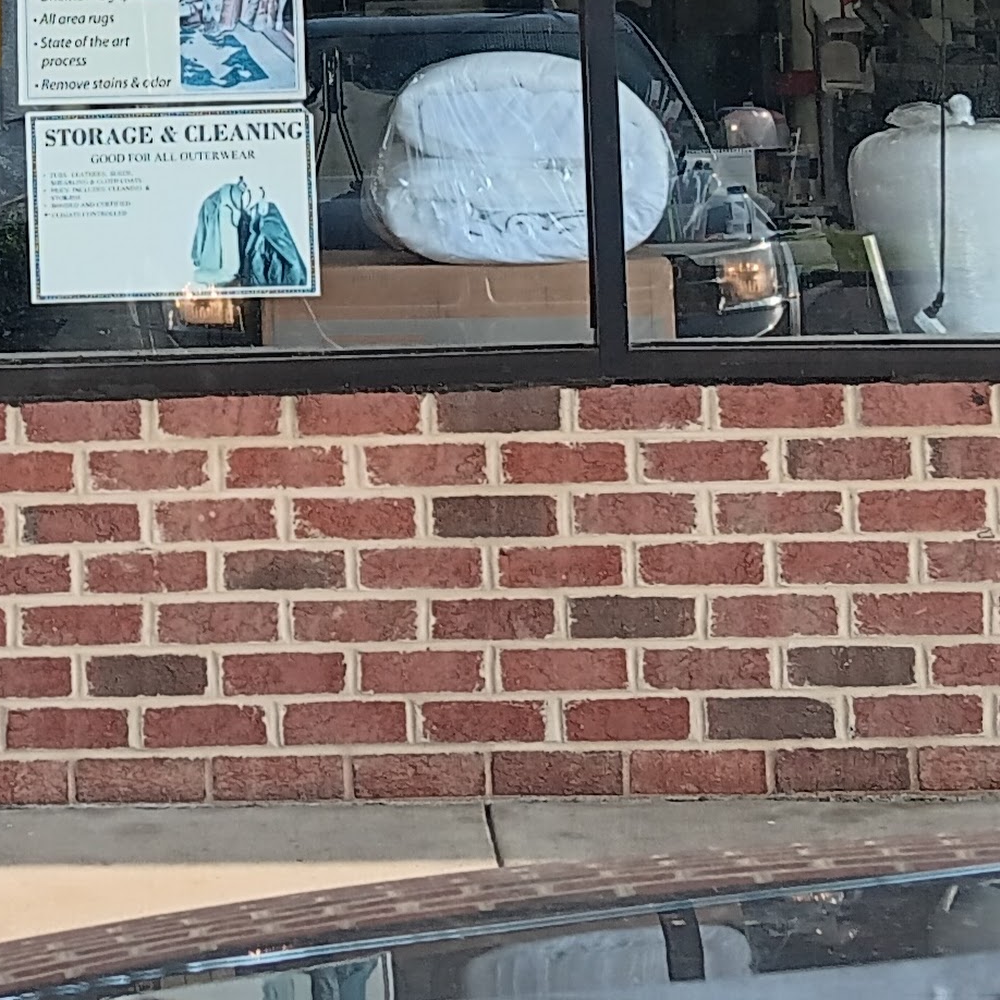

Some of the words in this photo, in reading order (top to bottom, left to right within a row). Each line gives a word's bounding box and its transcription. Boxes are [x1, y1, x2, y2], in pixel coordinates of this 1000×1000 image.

[39, 12, 56, 25] All
[58, 13, 86, 24] area
[88, 13, 114, 27] rugs
[40, 36, 72, 49] State
[74, 35, 88, 48] of
[89, 35, 109, 48] the
[111, 36, 130, 47] art
[41, 57, 87, 69] process
[41, 79, 90, 90] Remove
[92, 77, 128, 89] stains
[130, 76, 140, 88] &
[142, 75, 172, 88] odor
[45, 125, 154, 147] STORAGE
[160, 126, 178, 143] &
[184, 121, 303, 143] CLEANING
[90, 153, 126, 164] GOOD
[128, 152, 151, 163] FOR
[154, 151, 178, 162] ALL
[179, 150, 256, 162] OUTERWEAR
